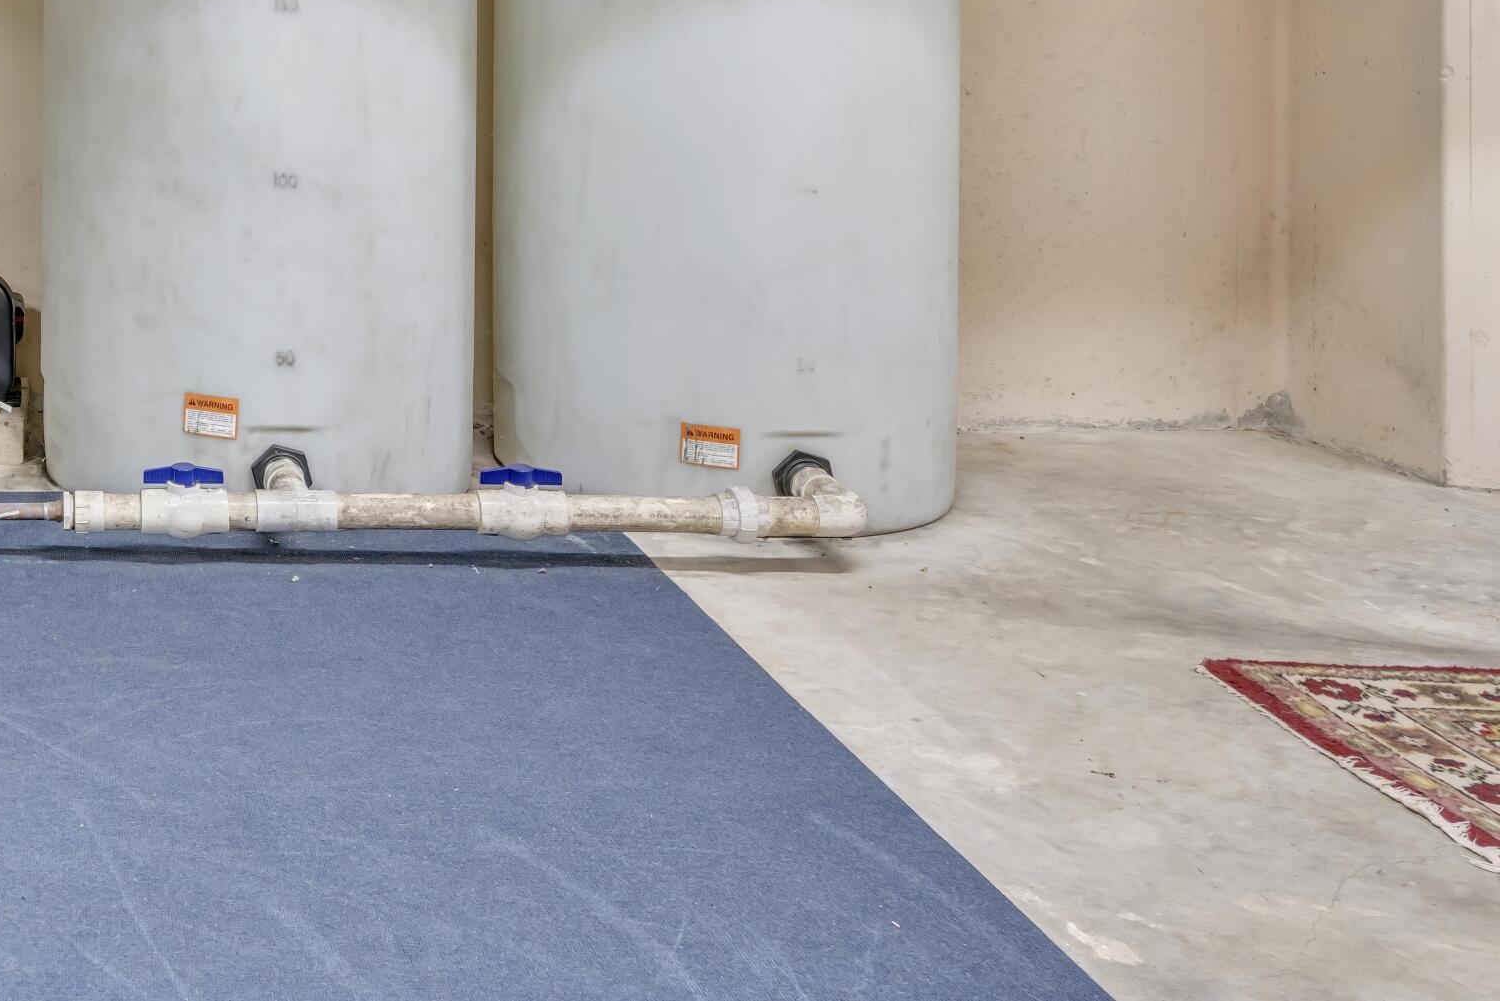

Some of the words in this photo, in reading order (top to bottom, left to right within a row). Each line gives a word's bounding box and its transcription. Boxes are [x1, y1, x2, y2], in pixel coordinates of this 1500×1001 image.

[273, 172, 299, 190] 100
[275, 351, 296, 367] 50
[196, 399, 234, 412] WARNING
[694, 429, 735, 442] WARNING
